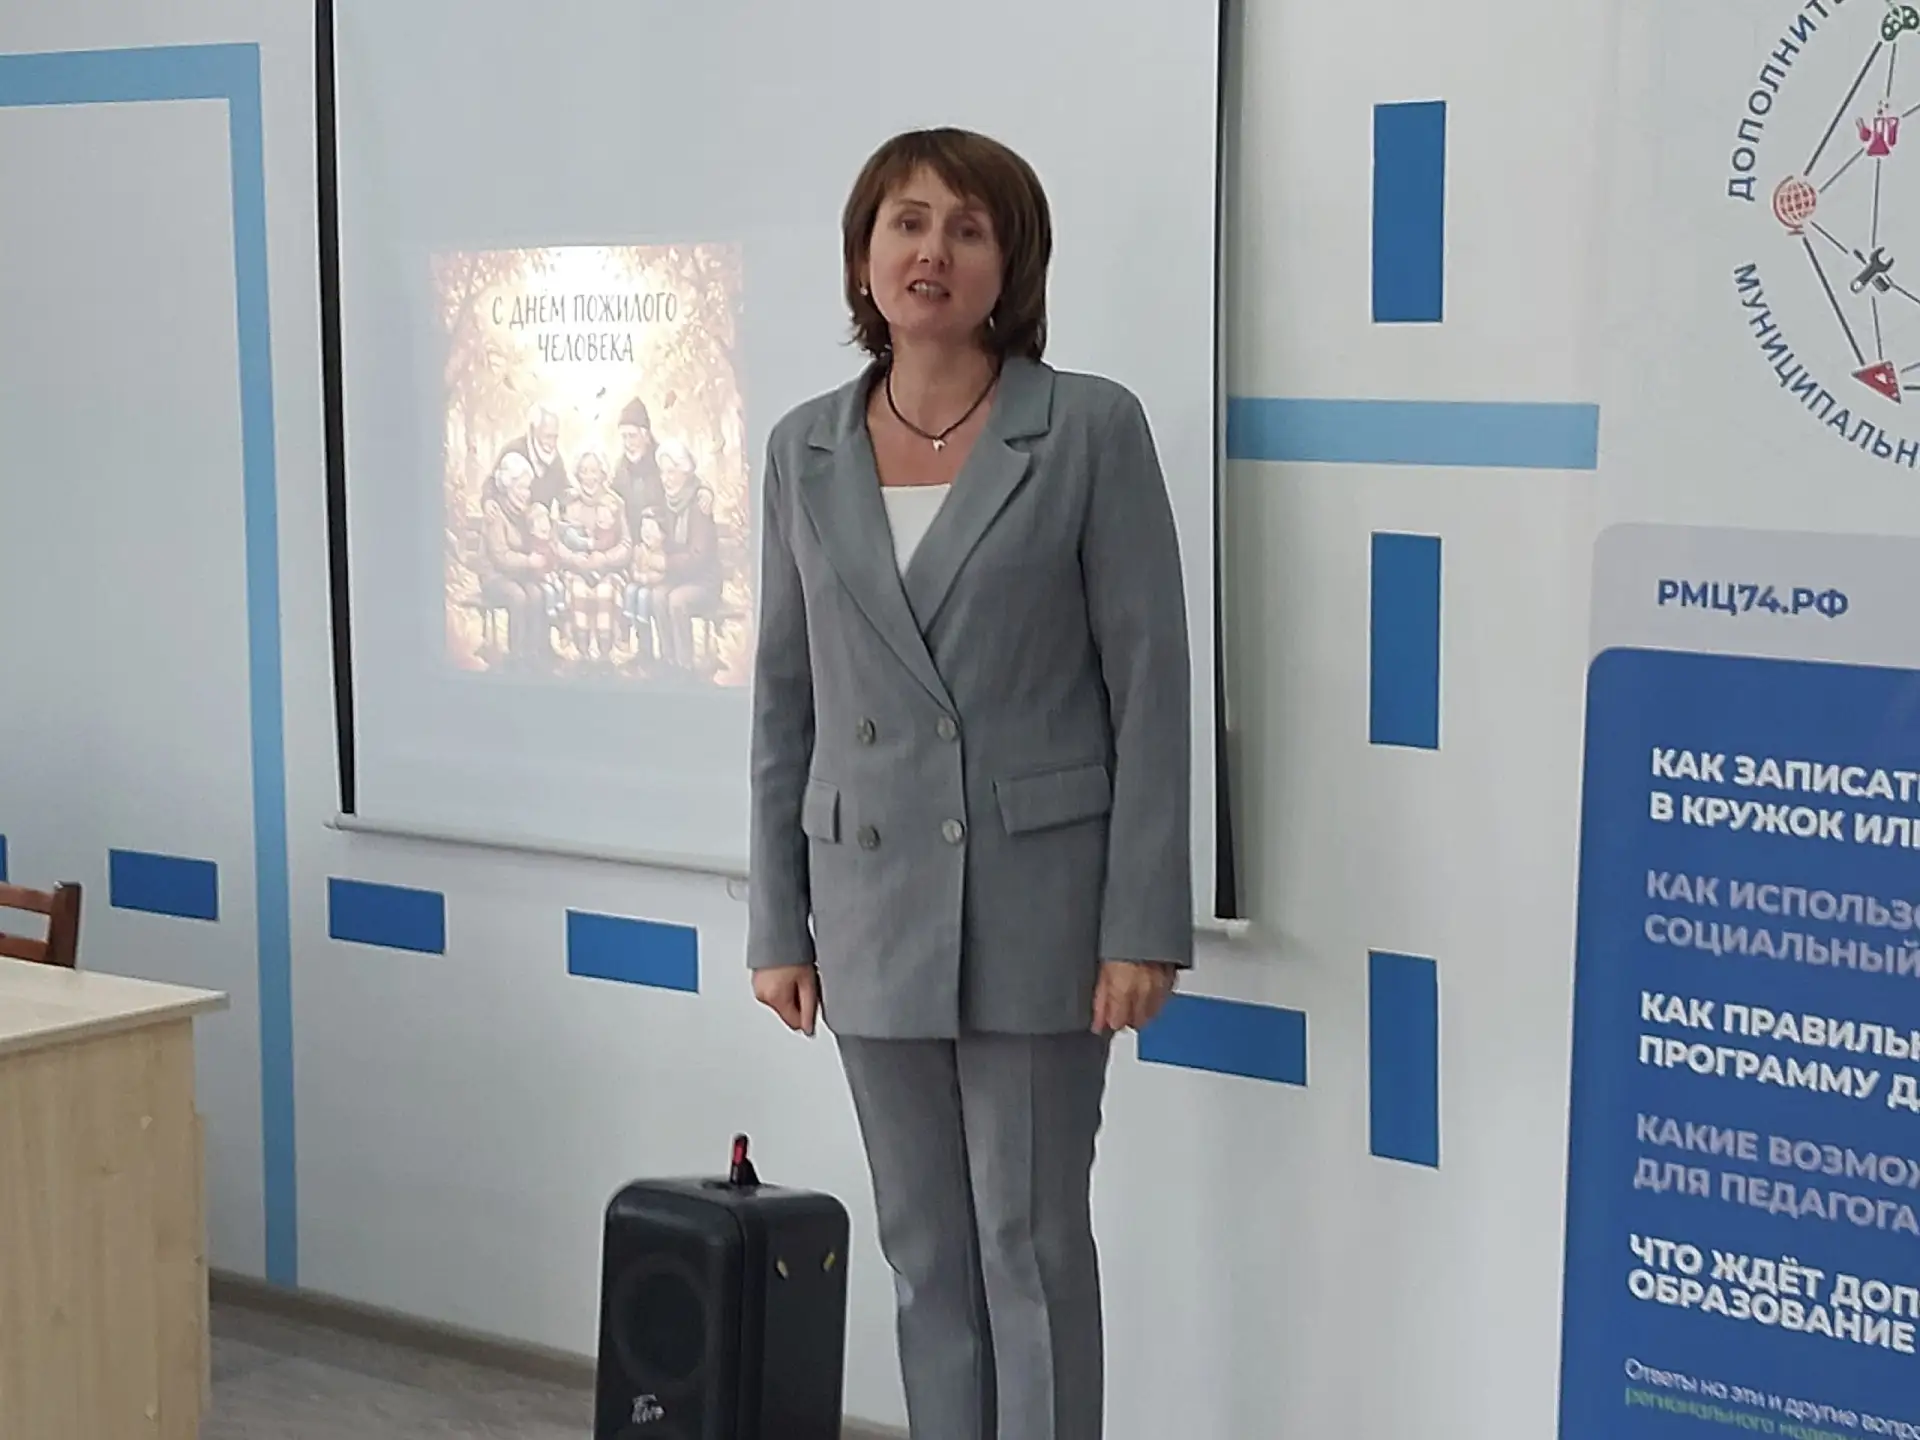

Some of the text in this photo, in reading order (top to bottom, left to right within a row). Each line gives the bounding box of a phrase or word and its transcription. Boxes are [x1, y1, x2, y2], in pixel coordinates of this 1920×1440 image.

[1727, 0, 1843, 202] ДОПОЛНИТ
[492, 296, 503, 325] С
[573, 292, 677, 323] ПОЖИЛОГО
[538, 332, 634, 363] ЧЕЛОВЕКА
[1657, 579, 1849, 618] РМЦ74.РФ
[1652, 747, 1920, 804] КАК ЗАПИСАТ
[1650, 791, 1673, 821] В
[1682, 795, 1844, 841] КРУЖОК
[1647, 869, 1719, 907] КАК
[1644, 914, 1920, 978] СОЦИАЛЬНЫЙ
[1640, 991, 1714, 1030] КАК
[1639, 1034, 1920, 1114] ПРОГРАММУ Д
[1637, 1112, 1759, 1162] КАКИЕ
[1634, 1157, 1920, 1236] ДЛЯ ПЕДАГОГА
[1630, 1233, 1920, 1319] ЧТО ЖДЁТ ДОП
[1628, 1268, 1916, 1354] ОБРАЗОВАНИЕ
[1625, 1358, 1698, 1393] Ответы
[1700, 1379, 1728, 1400] на
[1730, 1385, 1766, 1408] эти
[1767, 1394, 1781, 1411] и
[1784, 1397, 1859, 1428] другие
